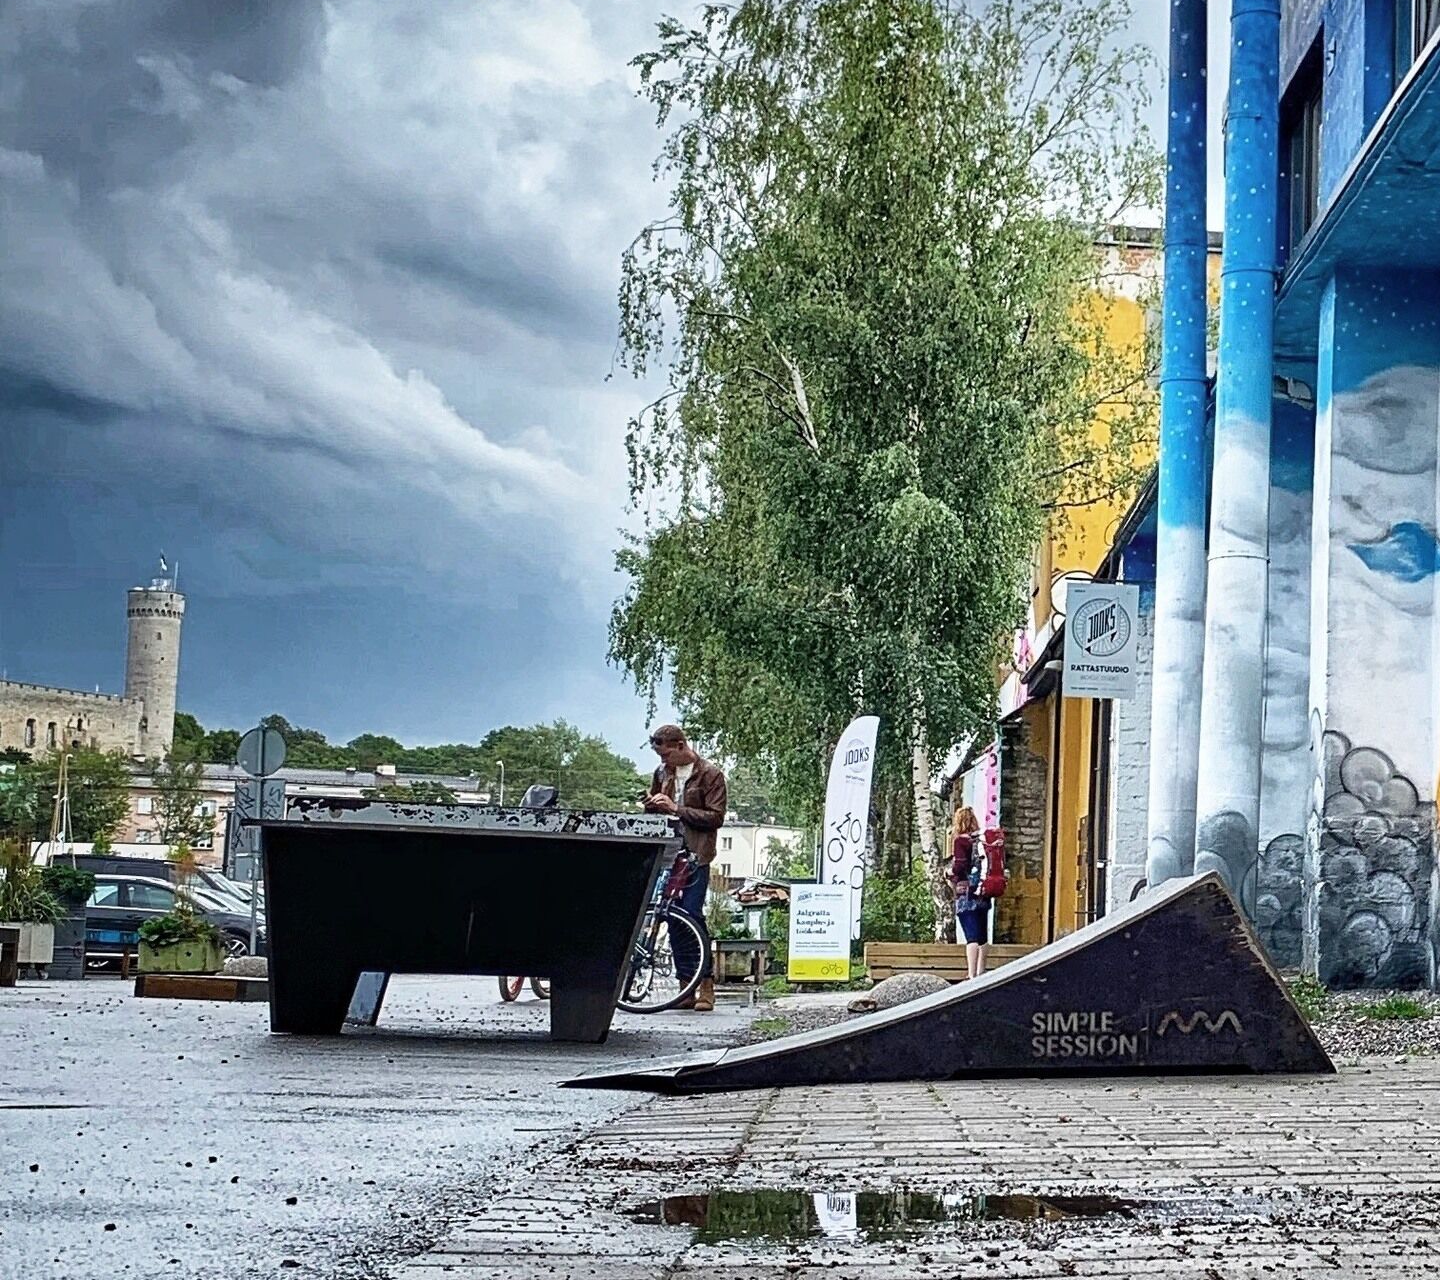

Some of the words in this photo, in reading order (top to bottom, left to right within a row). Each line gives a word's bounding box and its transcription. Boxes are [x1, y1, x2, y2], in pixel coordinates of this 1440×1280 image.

[1087, 604, 1116, 643] JOOKS
[1070, 664, 1130, 674] RATTASTUUDIO
[843, 746, 870, 767] JOOKS
[1032, 1011, 1114, 1034] SIMPLE
[1032, 1034, 1138, 1058] SESSION
